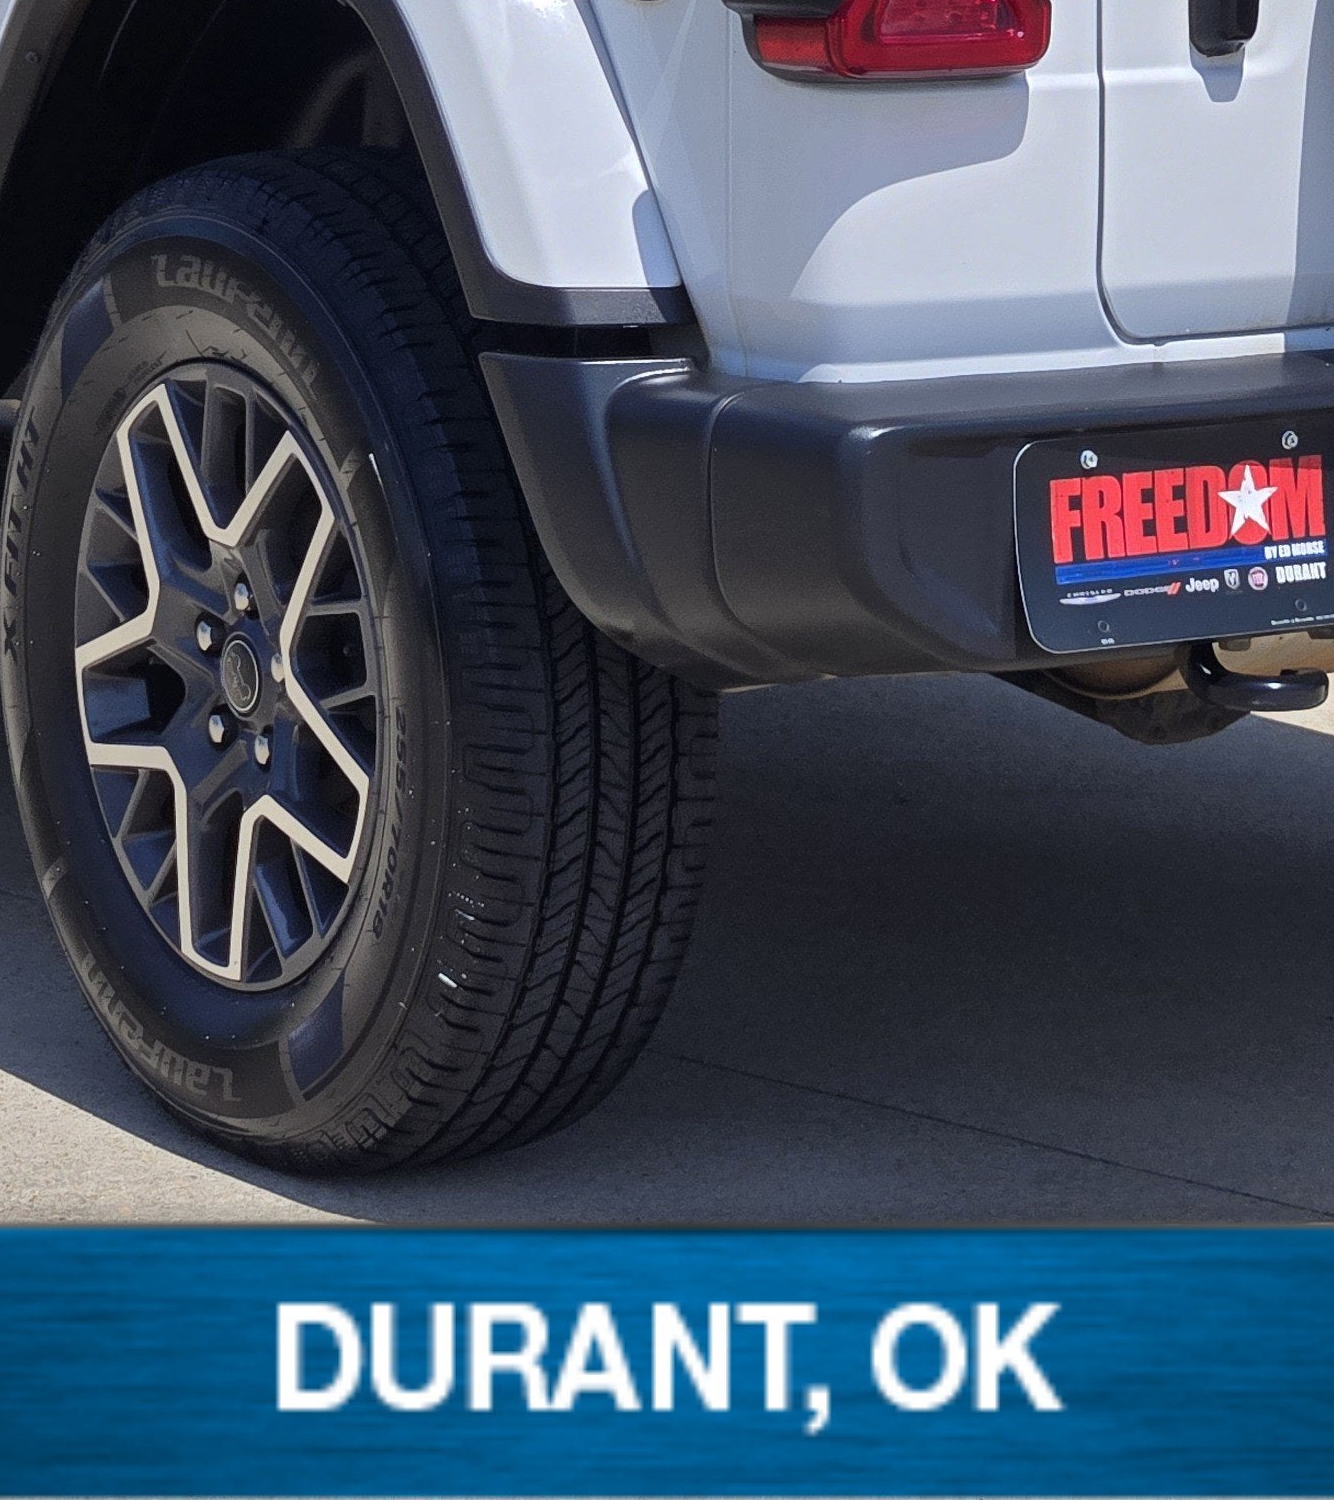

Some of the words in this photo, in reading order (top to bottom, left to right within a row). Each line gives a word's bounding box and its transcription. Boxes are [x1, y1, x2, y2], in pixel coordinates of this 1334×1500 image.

[1049, 455, 1326, 564] FREEDOM
[1278, 544, 1292, 558] ED
[1275, 561, 1327, 585] DURANT
[1185, 577, 1220, 595] Jeep
